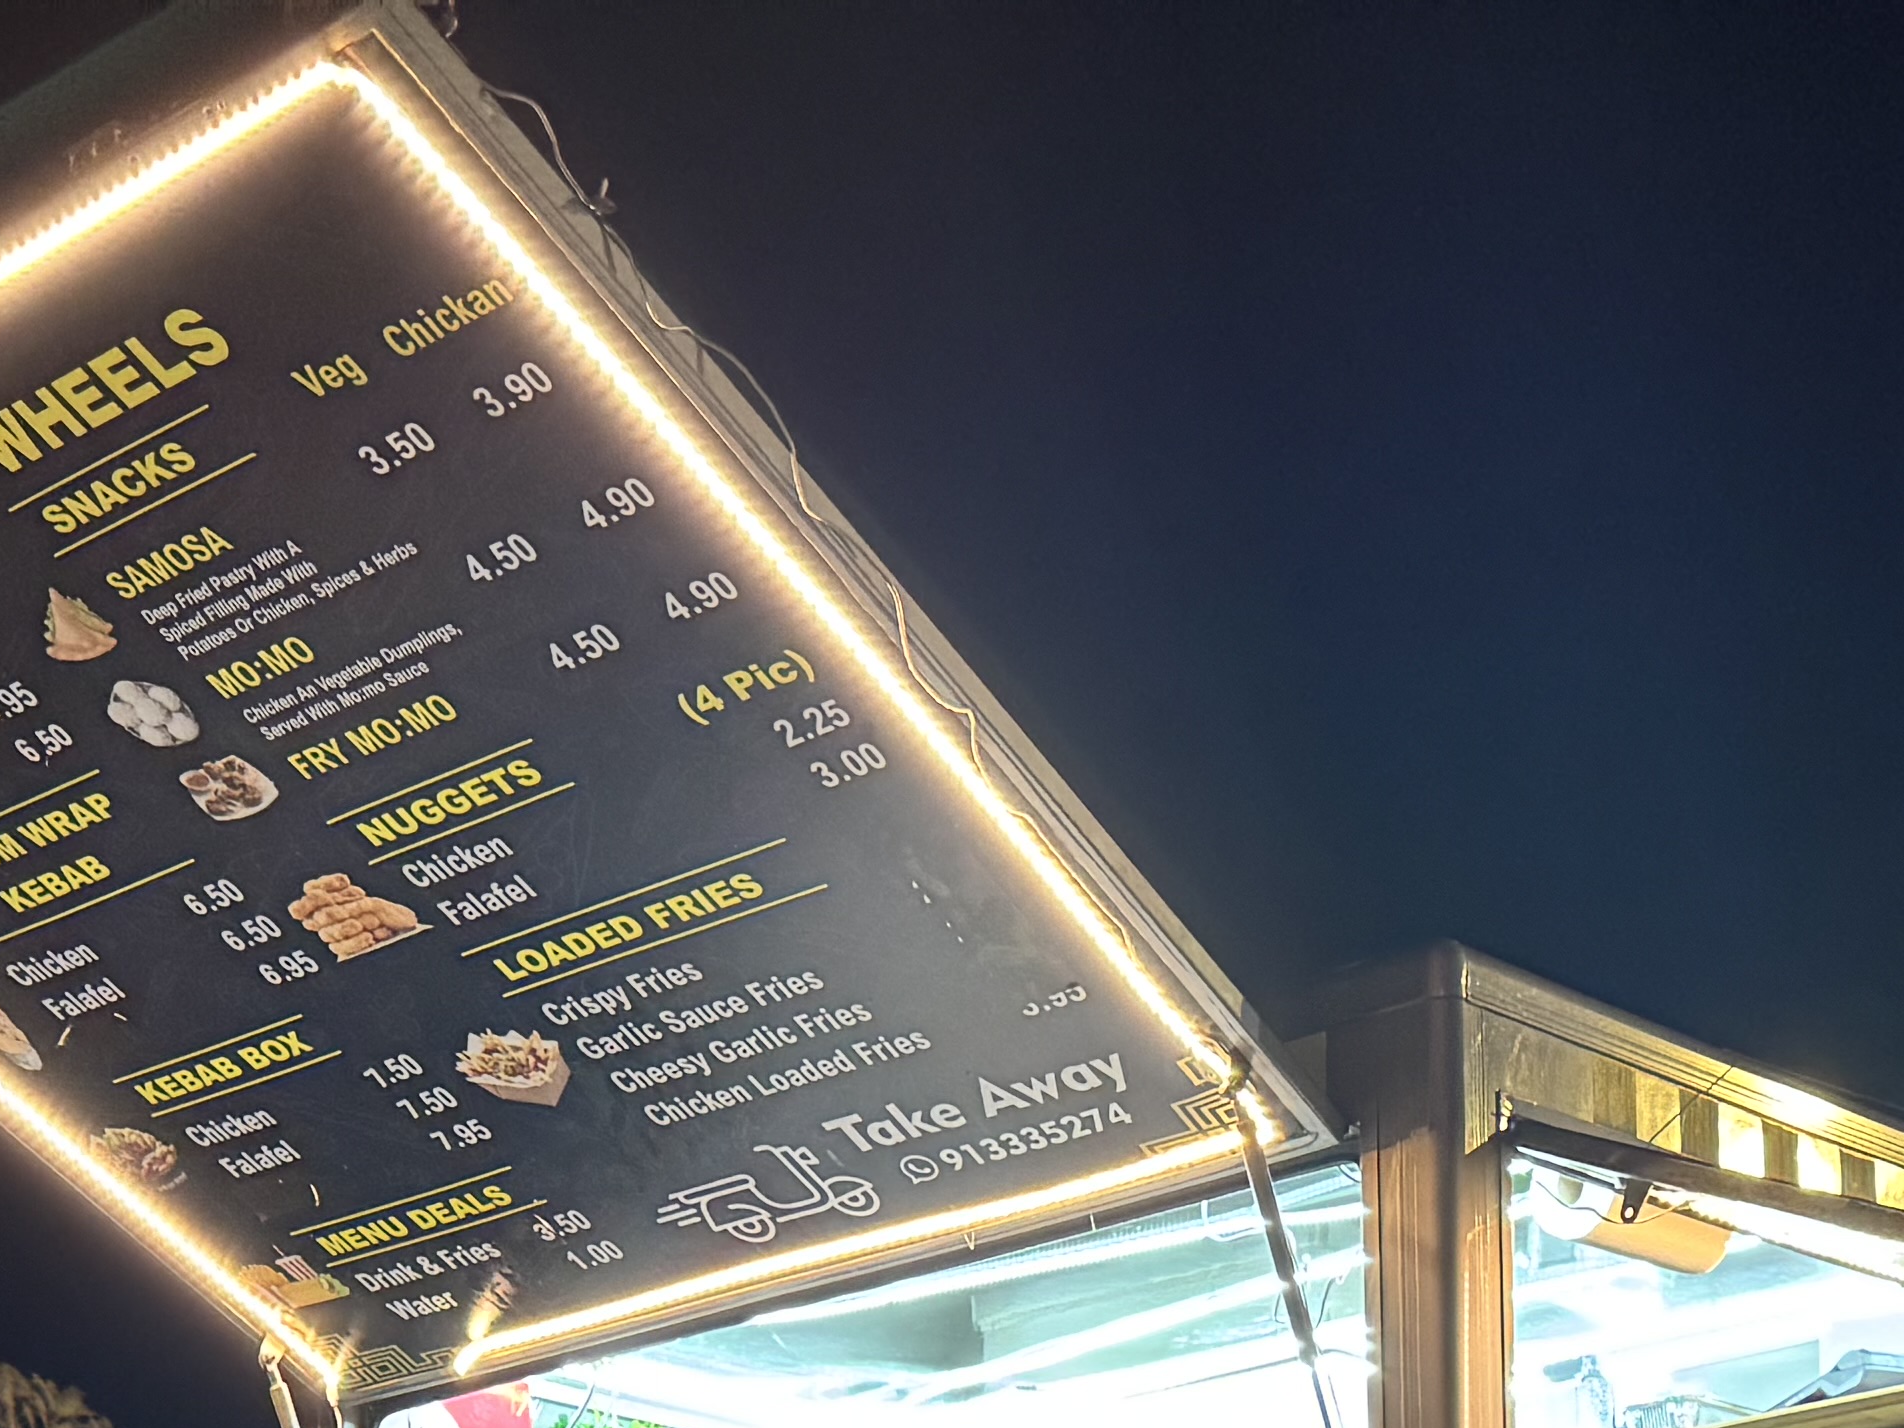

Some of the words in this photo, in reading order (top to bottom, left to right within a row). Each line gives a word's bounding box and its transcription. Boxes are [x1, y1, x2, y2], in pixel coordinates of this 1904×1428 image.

[290, 352, 368, 398] Veg
[382, 278, 515, 358] Chickan
[358, 421, 437, 476] 3.50
[472, 361, 553, 418] 3.90
[42, 442, 196, 534] SNACKS
[106, 526, 234, 600] SAMOSA
[465, 533, 537, 584] 4.50
[580, 477, 655, 530] 4.90
[140, 602, 179, 626] Deep
[211, 564, 257, 594] Pastry
[285, 539, 303, 557] A
[159, 613, 206, 644] Spiced
[247, 576, 285, 603] Made
[177, 626, 237, 661] Potatoes
[235, 617, 255, 633] Or
[311, 570, 362, 598] Spices
[357, 559, 375, 576] &
[371, 541, 418, 571] Herbs
[548, 623, 621, 673] 4.50
[664, 571, 739, 620] 4.90
[205, 636, 315, 700] MO:MO
[243, 694, 298, 724] Chicken
[295, 680, 319, 701] An
[316, 656, 383, 693] Vegetable
[260, 713, 309, 741] Served
[383, 660, 430, 689] Sauce
[677, 684, 725, 726] (4
[723, 649, 815, 702] Pic)
[14, 723, 73, 763] 6.50
[287, 737, 350, 781] FRY
[344, 694, 458, 757] MO:MO
[773, 699, 851, 748] 2.25
[810, 742, 887, 788] 3.00
[17, 792, 112, 849] WRAP
[356, 759, 543, 847] NUGGETS
[401, 836, 514, 888] Chicken
[183, 878, 244, 916] 6.50
[436, 874, 537, 926] Falafel
[493, 915, 643, 982] LOADED
[644, 873, 764, 930] FRIES
[6, 943, 100, 987] Chicken
[220, 915, 282, 952] 6.50
[41, 976, 127, 1021] Falafel
[258, 950, 320, 986] 6.95
[542, 984, 632, 1026] Crispy
[627, 961, 703, 1000] Fries
[576, 1020, 663, 1061] Garlic
[659, 995, 750, 1034] Sauce
[745, 970, 824, 1007] Fries
[611, 1051, 712, 1094] Cheesy
[709, 1024, 798, 1064] Garlic
[793, 1001, 873, 1039] Fries
[134, 1056, 243, 1105] KEBAB
[237, 1030, 315, 1071] BOX
[363, 1053, 424, 1089] 7.50
[644, 1084, 753, 1127] Chicken
[748, 1048, 856, 1096] Loaded
[852, 1029, 932, 1066] Fries
[185, 1108, 277, 1148] Chicken
[395, 1086, 458, 1120] 7.50
[429, 1118, 492, 1151] 7.95
[821, 1102, 967, 1153] Take
[978, 1052, 1127, 1118] Away
[218, 1140, 301, 1179] Falafel
[939, 1101, 1133, 1171] 913335274
[316, 1215, 409, 1257] MENU
[406, 1185, 513, 1231] DEALS
[532, 1209, 593, 1242] 3.50
[355, 1263, 422, 1293] Drink
[416, 1255, 444, 1276] &
[437, 1241, 502, 1270] Fries
[566, 1240, 625, 1270] 1.00
[385, 1291, 459, 1321] Water
